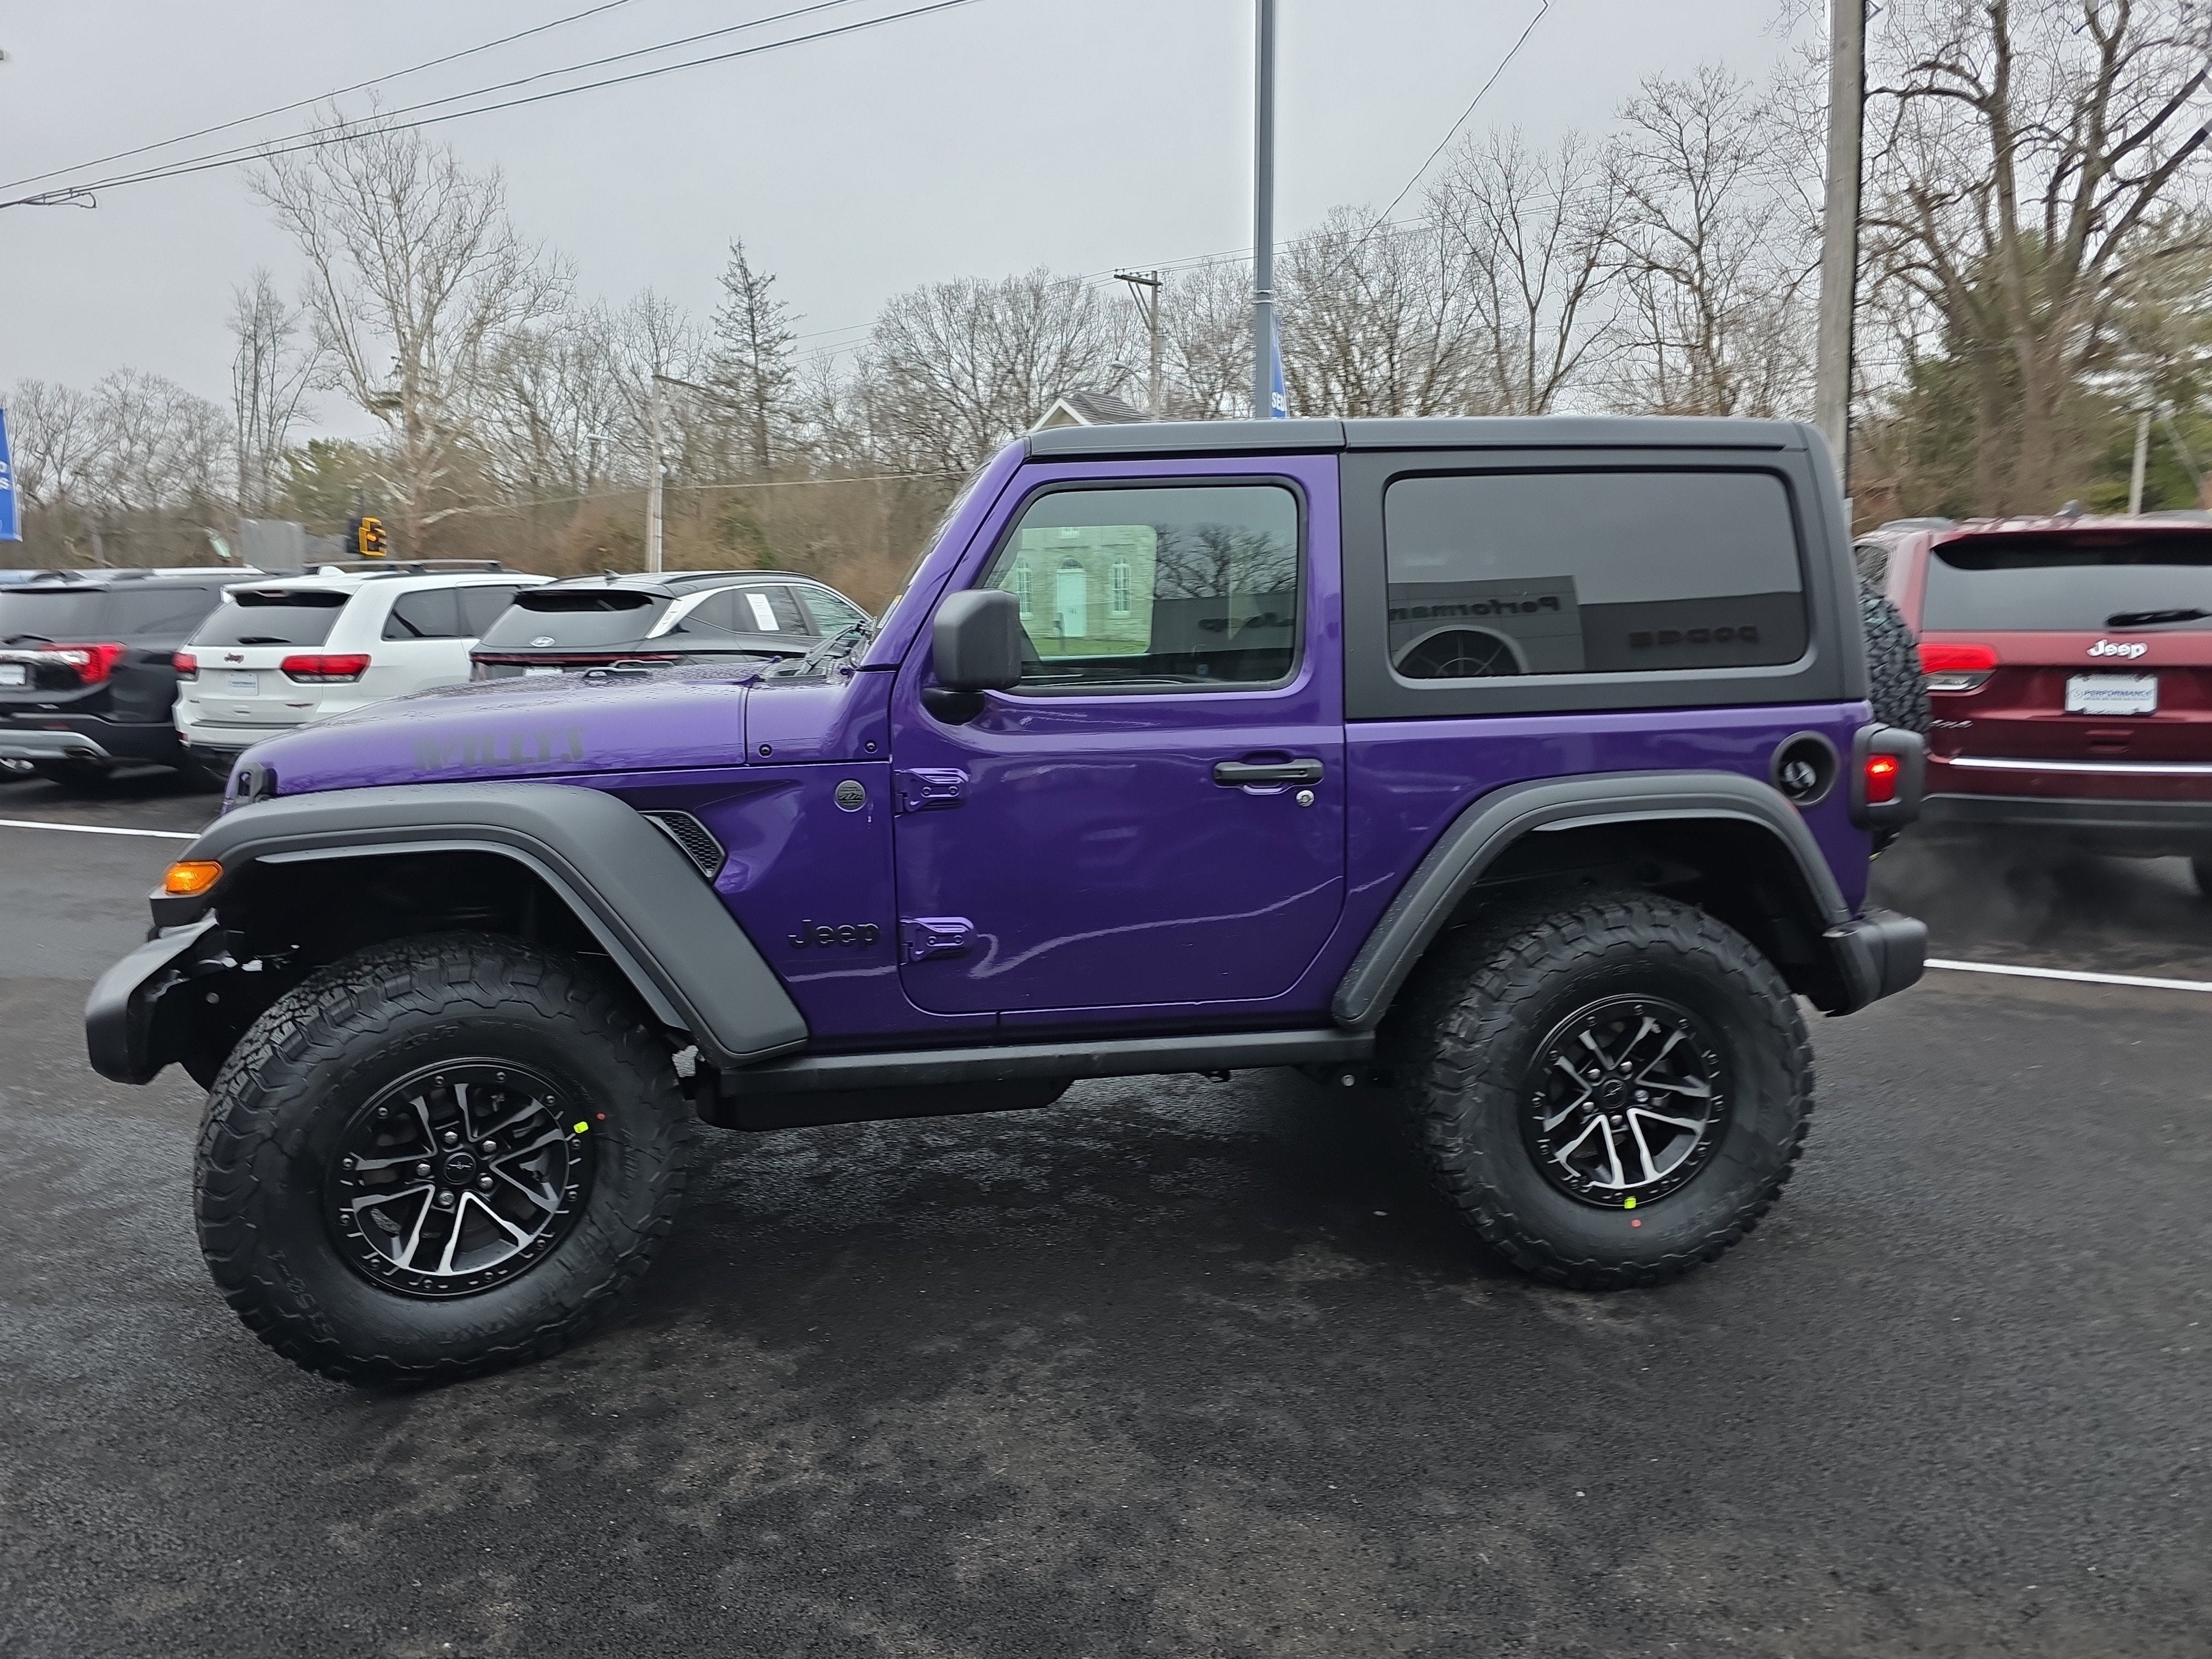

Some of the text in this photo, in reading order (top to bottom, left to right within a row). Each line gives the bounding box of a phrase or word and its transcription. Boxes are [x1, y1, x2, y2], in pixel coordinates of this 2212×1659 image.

[1271, 391, 1285, 412] SED
[2087, 639, 2148, 660] Jeep
[2083, 689, 2155, 698] PERFORMANCE
[788, 919, 880, 950] Jeep
